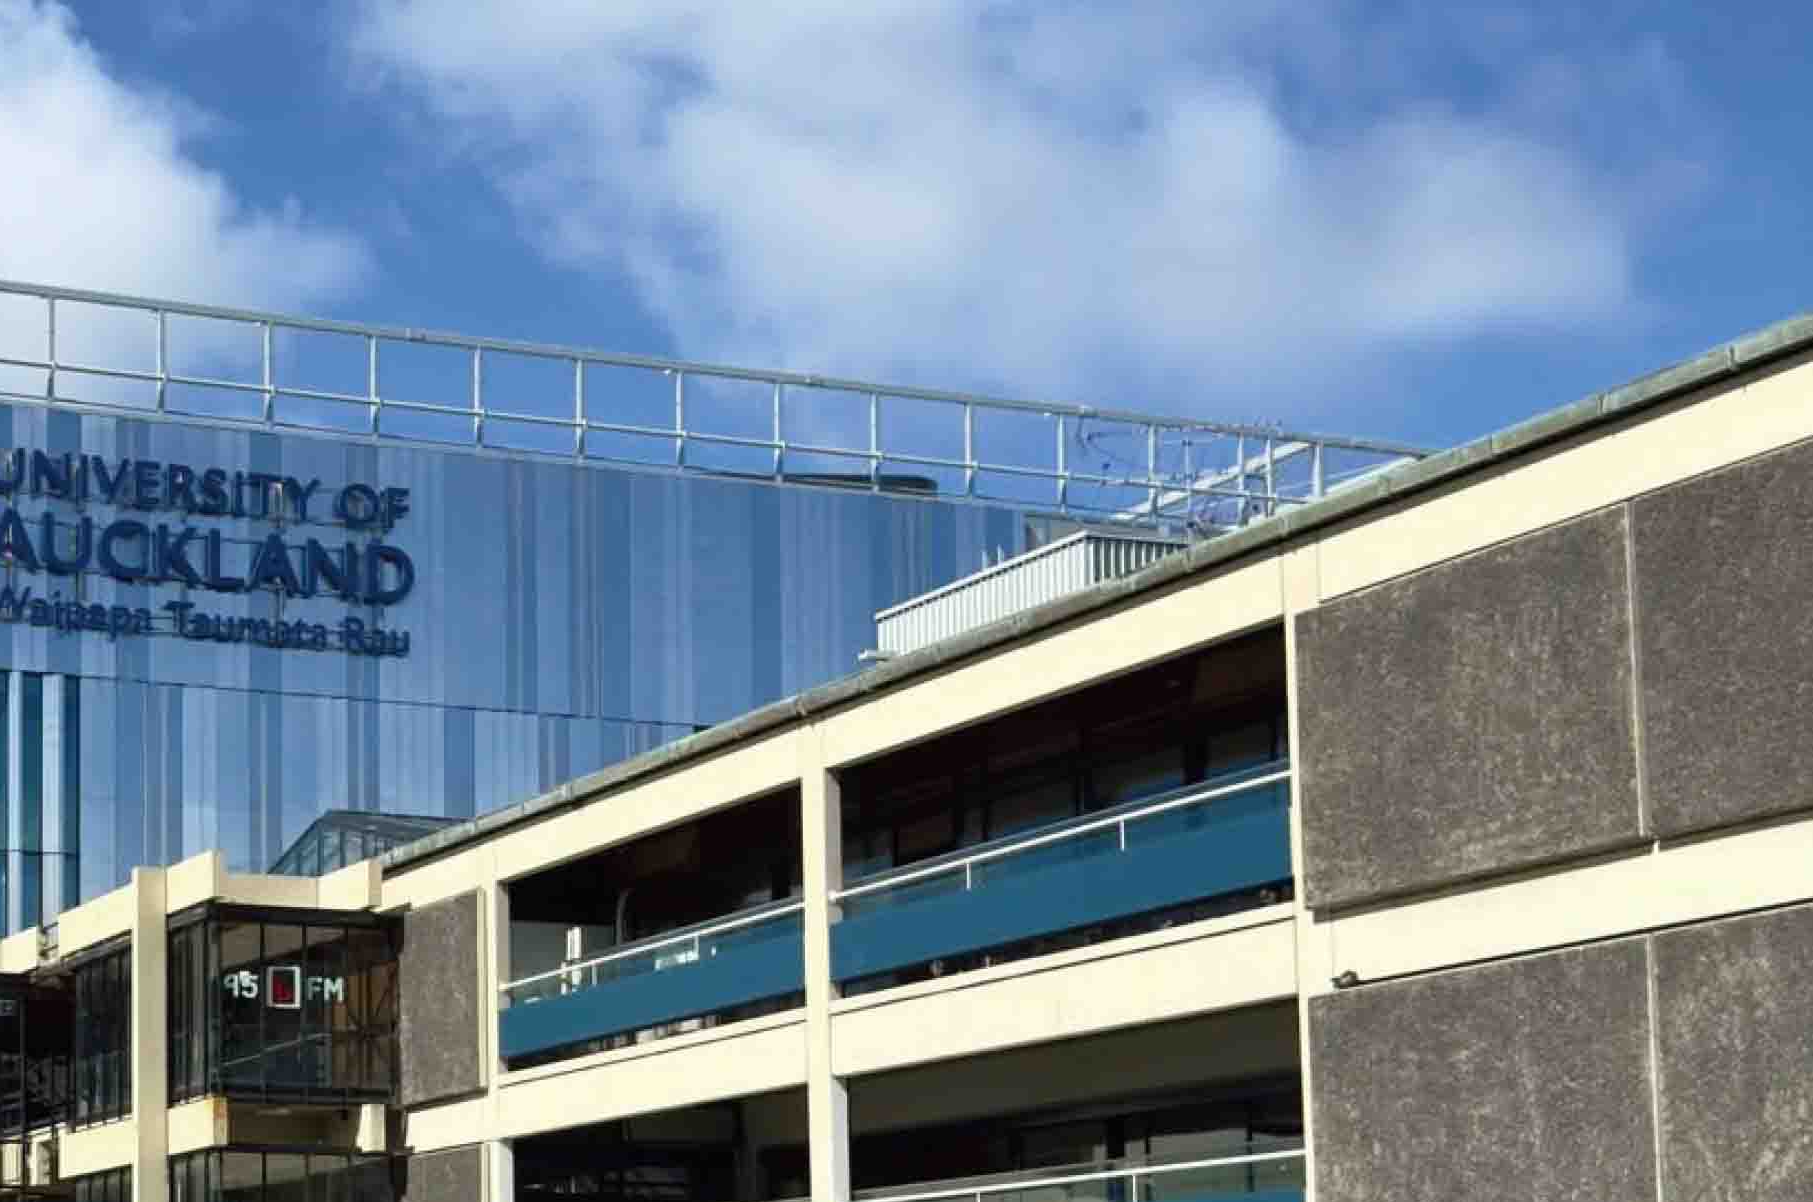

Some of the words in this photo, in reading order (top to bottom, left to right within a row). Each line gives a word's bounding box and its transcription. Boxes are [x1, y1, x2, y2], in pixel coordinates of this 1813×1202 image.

[333, 483, 410, 532] OF
[164, 600, 327, 652] Taumata
[340, 616, 410, 657] Rau
[223, 971, 258, 999] 95
[307, 976, 345, 1003] FM
